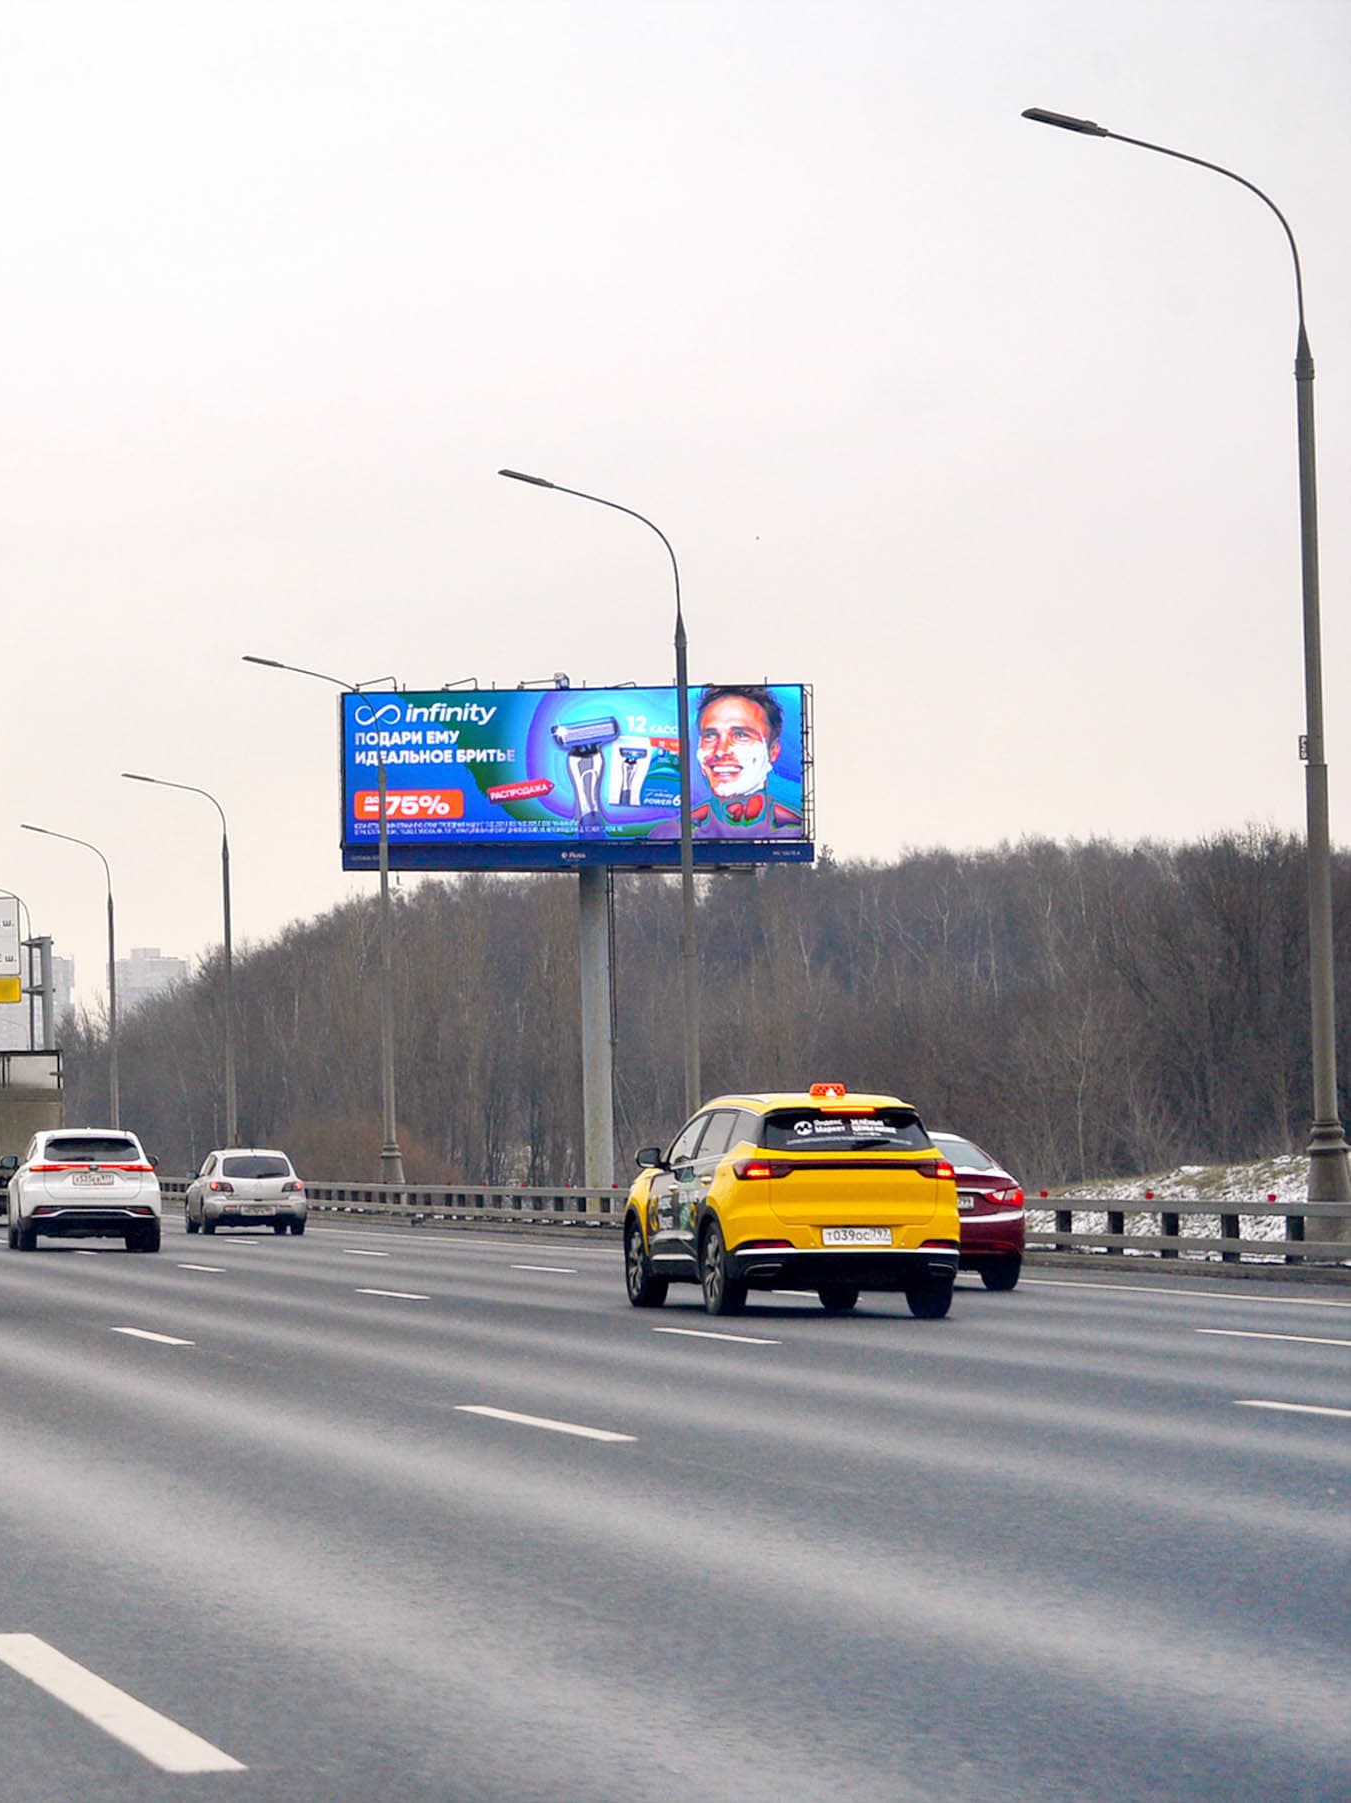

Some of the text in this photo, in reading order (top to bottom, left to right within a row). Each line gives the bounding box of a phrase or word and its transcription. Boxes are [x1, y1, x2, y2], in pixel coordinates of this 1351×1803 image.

[405, 703, 497, 725] infinity
[626, 715, 647, 733] 12
[355, 731, 459, 747] ПОДАРИ ЕМУ
[355, 749, 515, 766] ИДЕАЛЬНОЕ БРИТЬЕ
[490, 783, 548, 800] РАСПРОДАЖА
[3, 920, 14, 928] ш.
[5, 955, 17, 963] ш.
